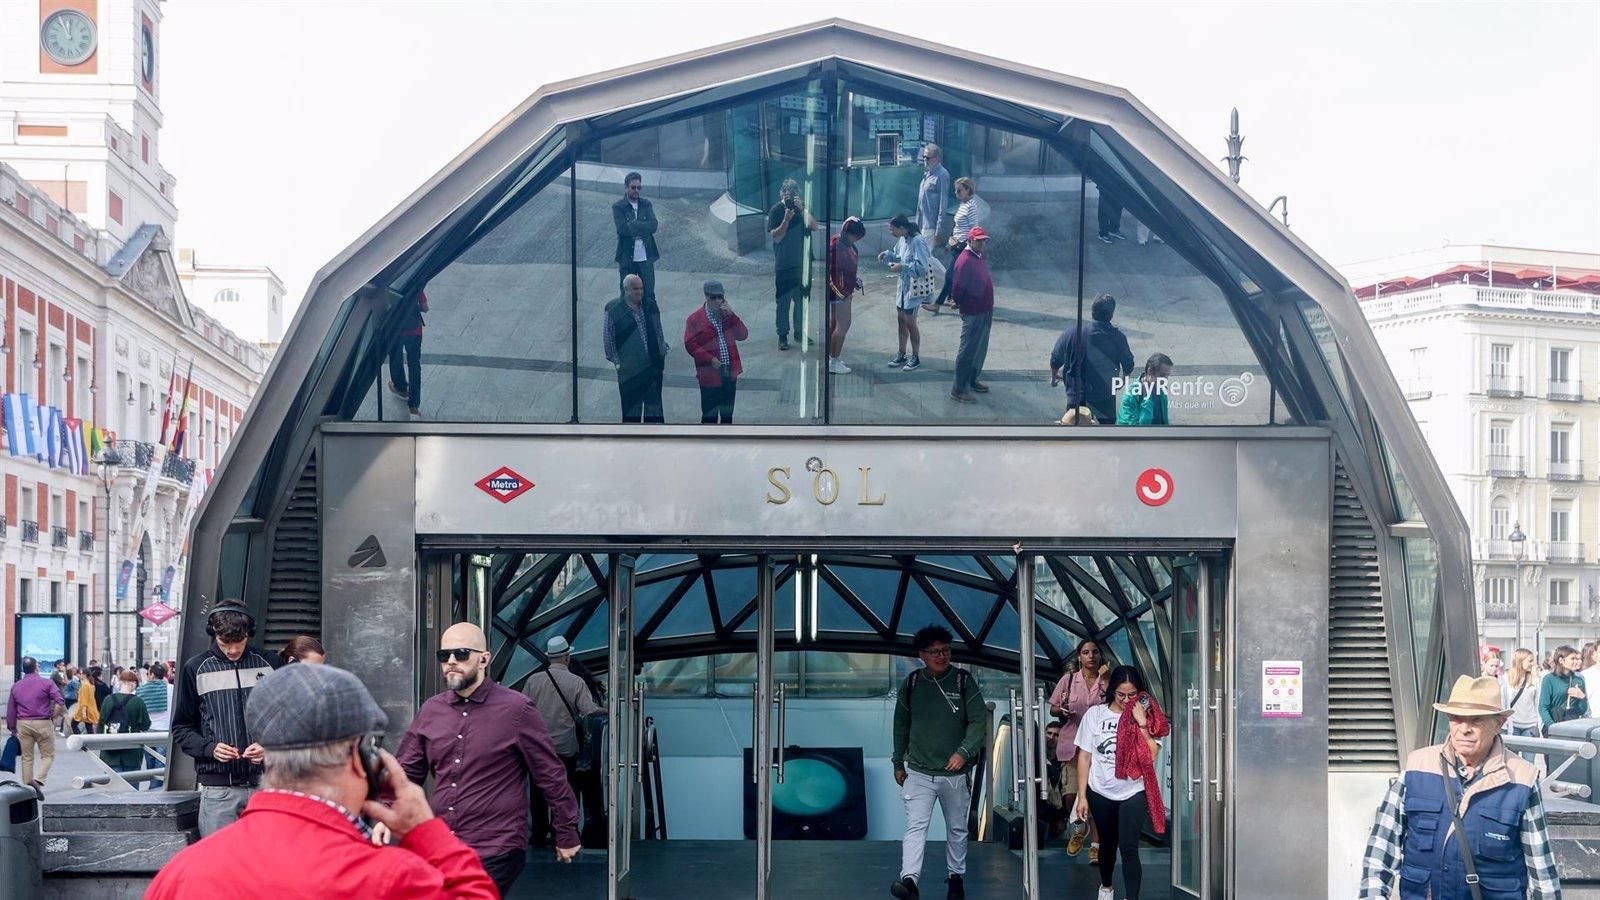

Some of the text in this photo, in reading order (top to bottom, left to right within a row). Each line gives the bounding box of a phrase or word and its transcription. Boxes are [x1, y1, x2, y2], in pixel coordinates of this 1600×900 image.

[1111, 376, 1215, 400] PlayRenfe
[1184, 401, 1200, 410] que
[491, 480, 518, 489] Metro
[766, 466, 886, 505] SOL
